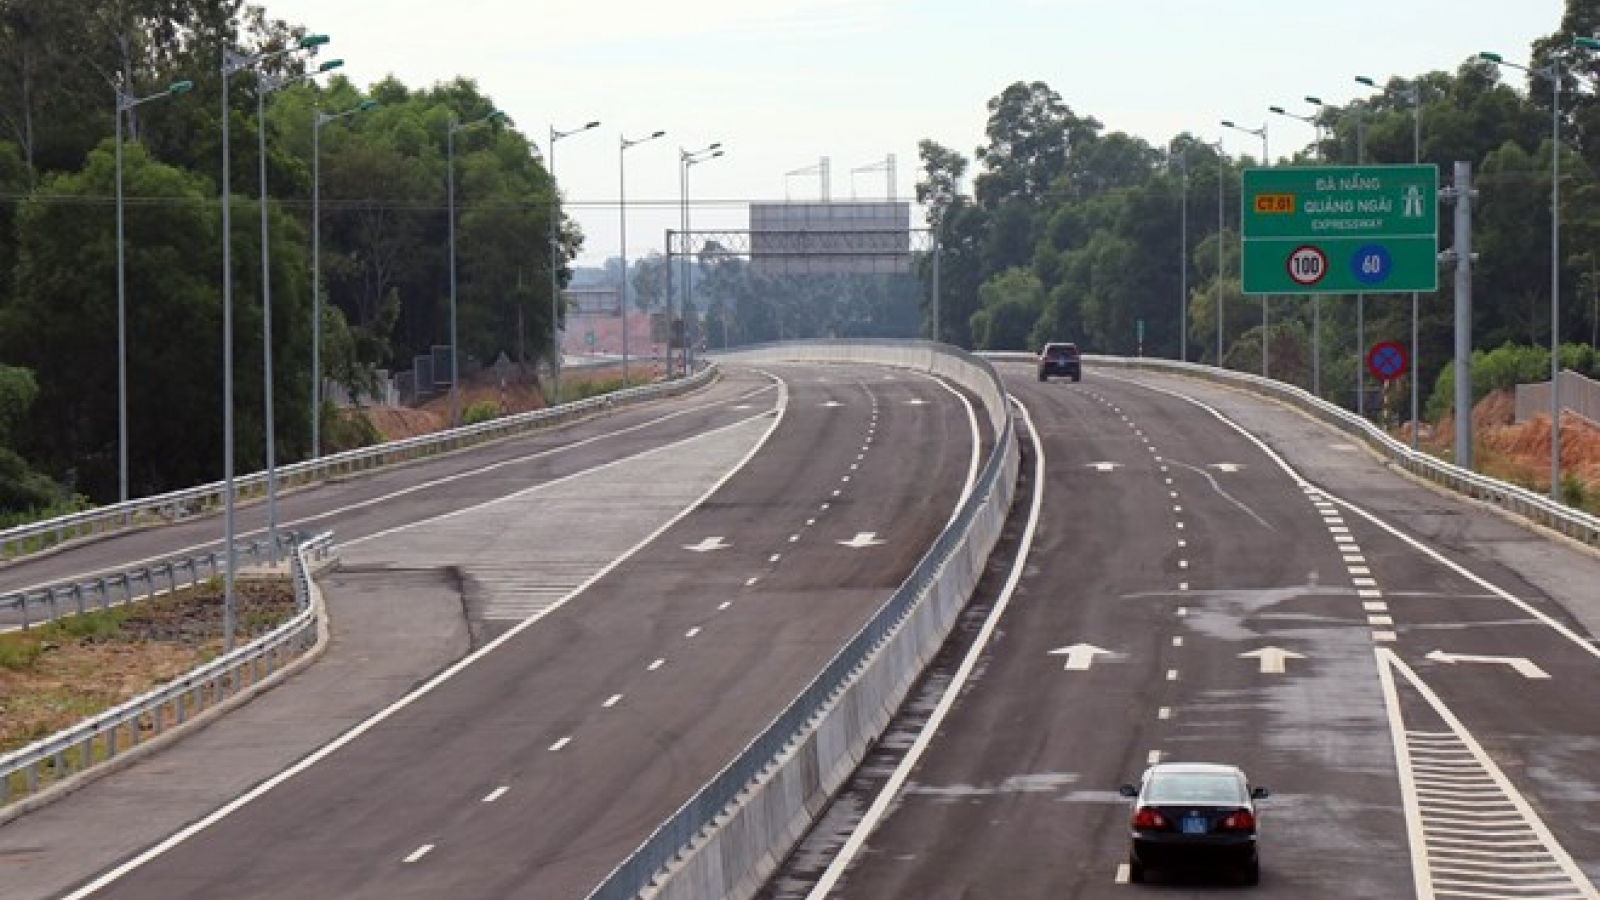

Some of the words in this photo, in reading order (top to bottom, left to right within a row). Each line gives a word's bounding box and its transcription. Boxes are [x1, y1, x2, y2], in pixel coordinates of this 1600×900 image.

[1257, 197, 1291, 211] CT.01
[1311, 219, 1382, 230] EXPRESSWAY
[1294, 257, 1319, 274] 100
[1362, 255, 1380, 273] 60
